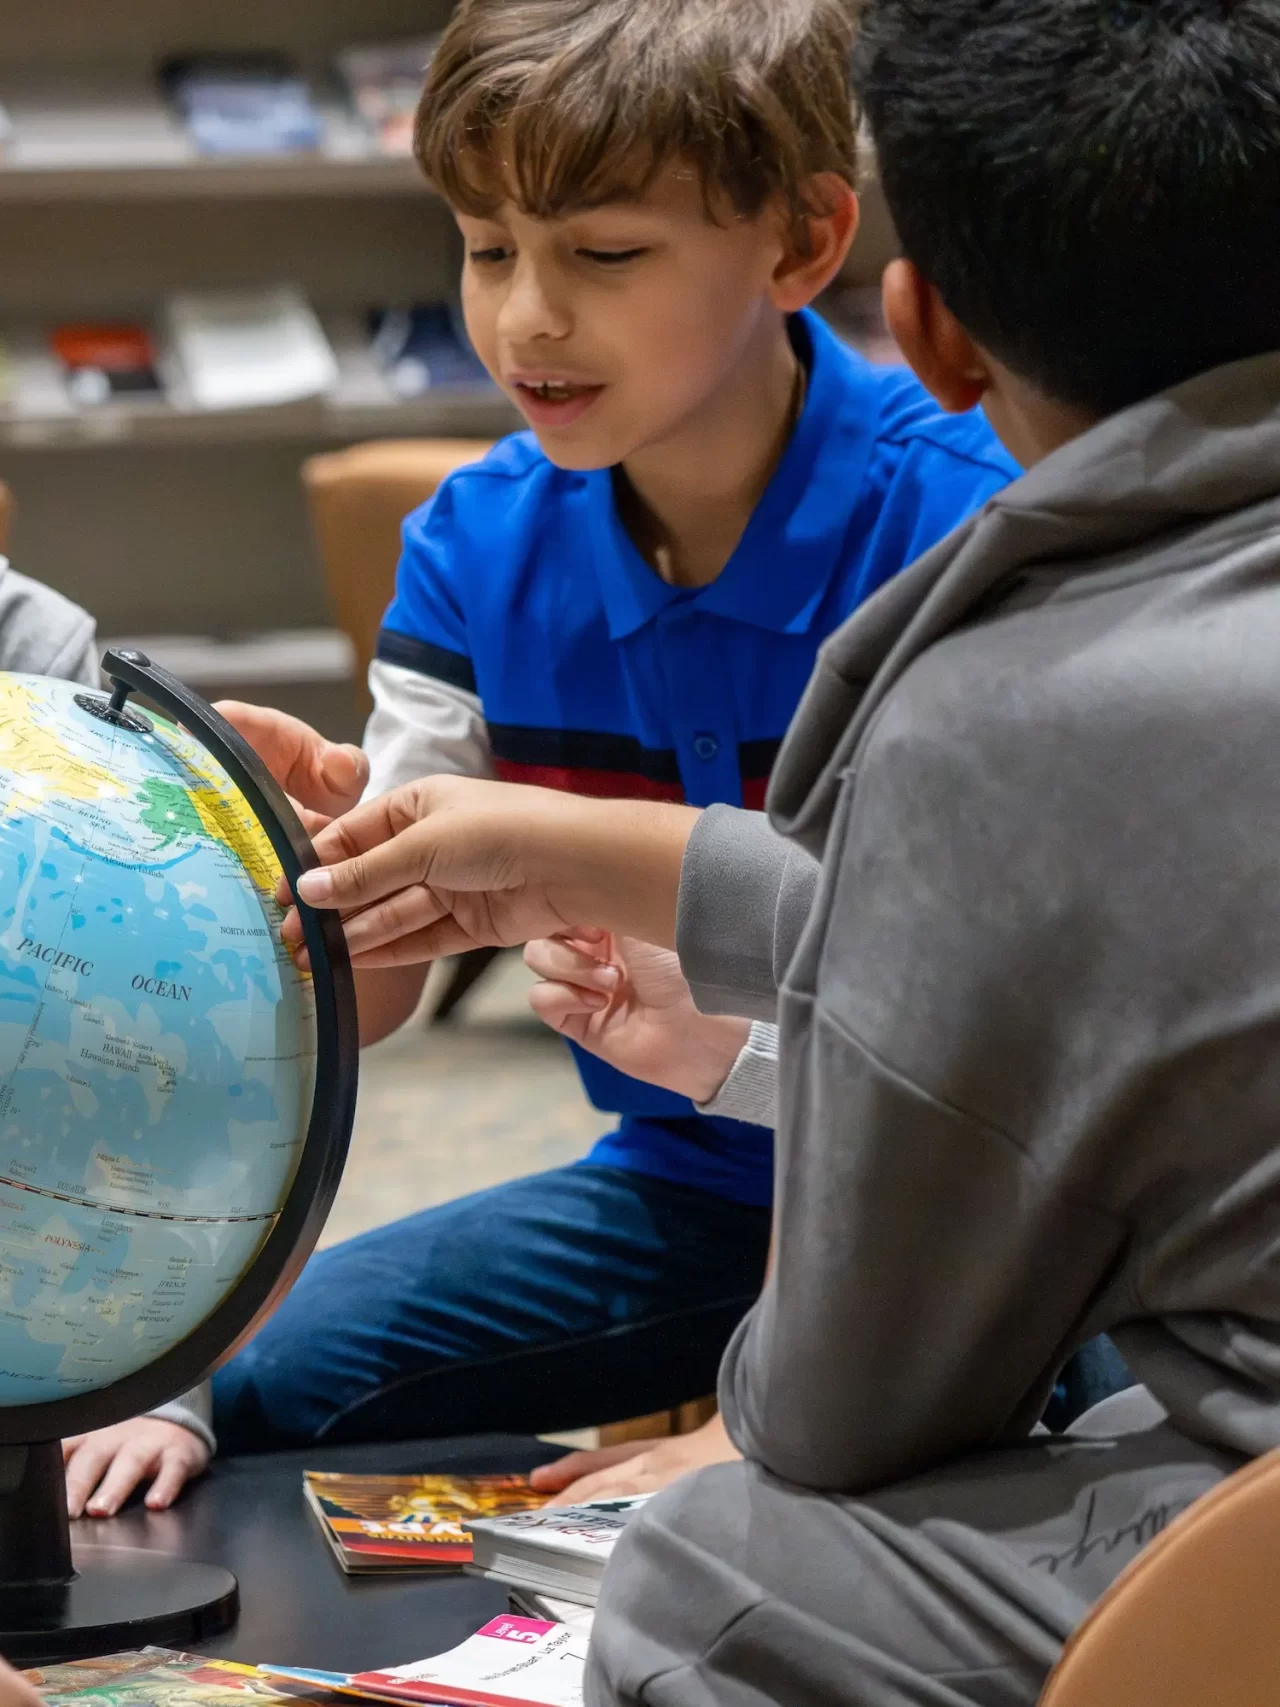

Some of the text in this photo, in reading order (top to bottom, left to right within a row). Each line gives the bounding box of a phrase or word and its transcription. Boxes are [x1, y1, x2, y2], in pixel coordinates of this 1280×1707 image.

[220, 926, 271, 937] NORTH AMERIC
[16, 937, 94, 977] PACIFIC
[131, 974, 192, 1001] OCEAN
[102, 1043, 132, 1059] HAWAII
[80, 1048, 114, 1067] Hawaiian
[116, 1059, 140, 1073] Islands
[45, 1234, 90, 1253] POLYNESIA
[488, 1622, 515, 1637] Level
[506, 1630, 542, 1642] 5
